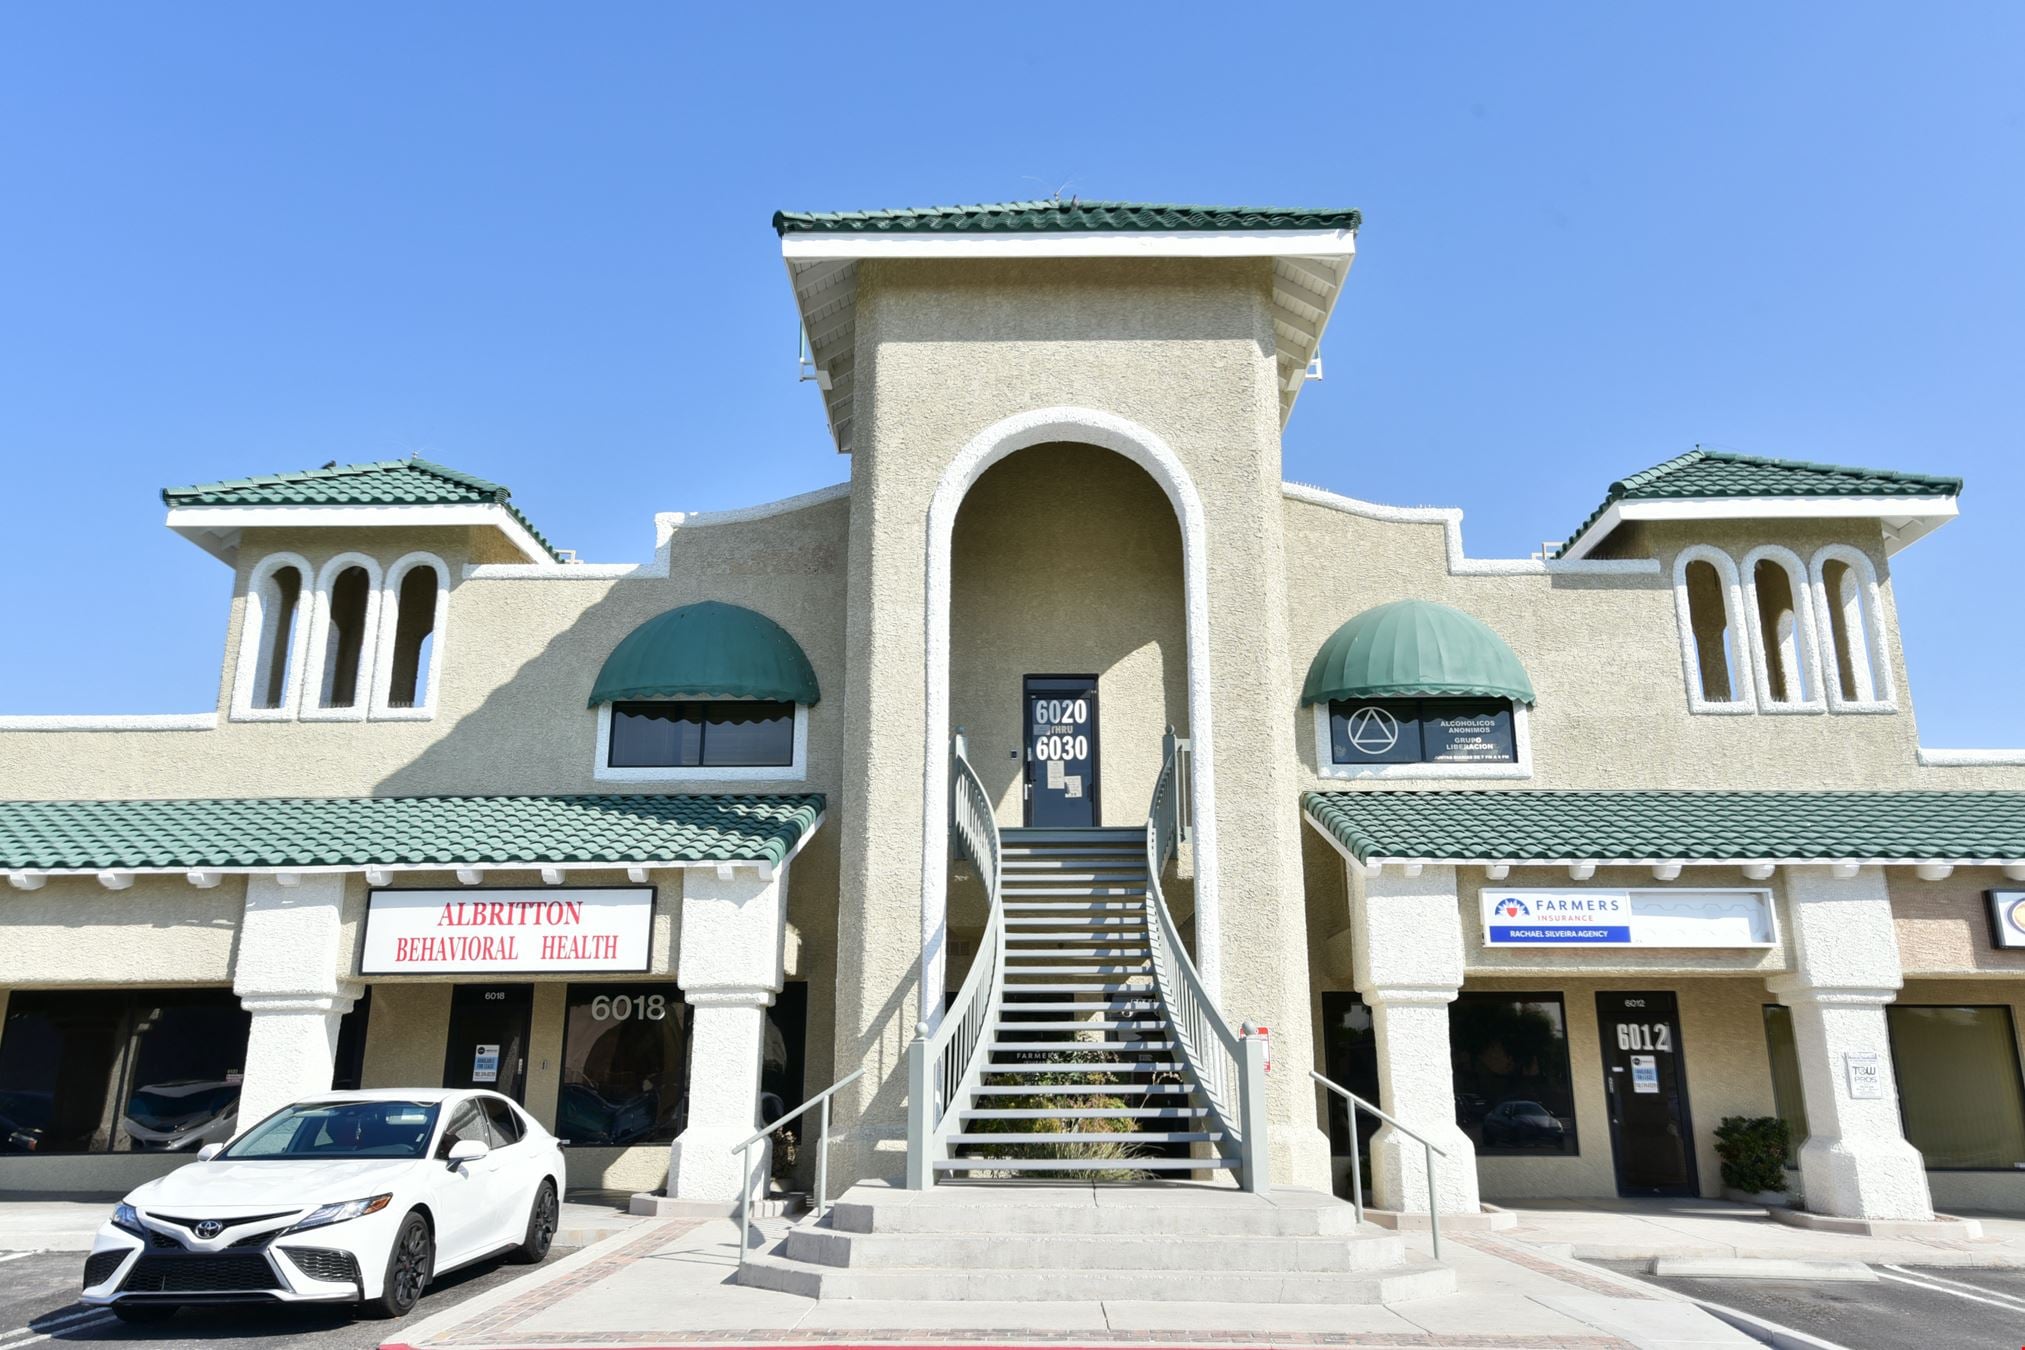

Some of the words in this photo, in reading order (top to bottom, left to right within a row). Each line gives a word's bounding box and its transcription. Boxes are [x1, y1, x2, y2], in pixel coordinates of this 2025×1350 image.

[1035, 699, 1087, 724] 6020
[1051, 725, 1074, 734] THRU
[1035, 735, 1088, 761] 6030
[437, 900, 583, 927] ALBRITTON
[1535, 899, 1619, 911] FARMERS
[1537, 914, 1594, 922] INSURANCE
[1509, 930, 1544, 938] RACHAEL
[1545, 930, 1578, 938] SILVEIRA
[1578, 930, 1608, 938] AGENCY
[394, 935, 519, 962] BEHAVIORAL
[540, 934, 619, 960] HEALTH
[484, 991, 505, 1000] 6018
[1624, 999, 1646, 1008] 6012
[590, 993, 667, 1022] 6018
[1616, 1023, 1669, 1051] 6012
